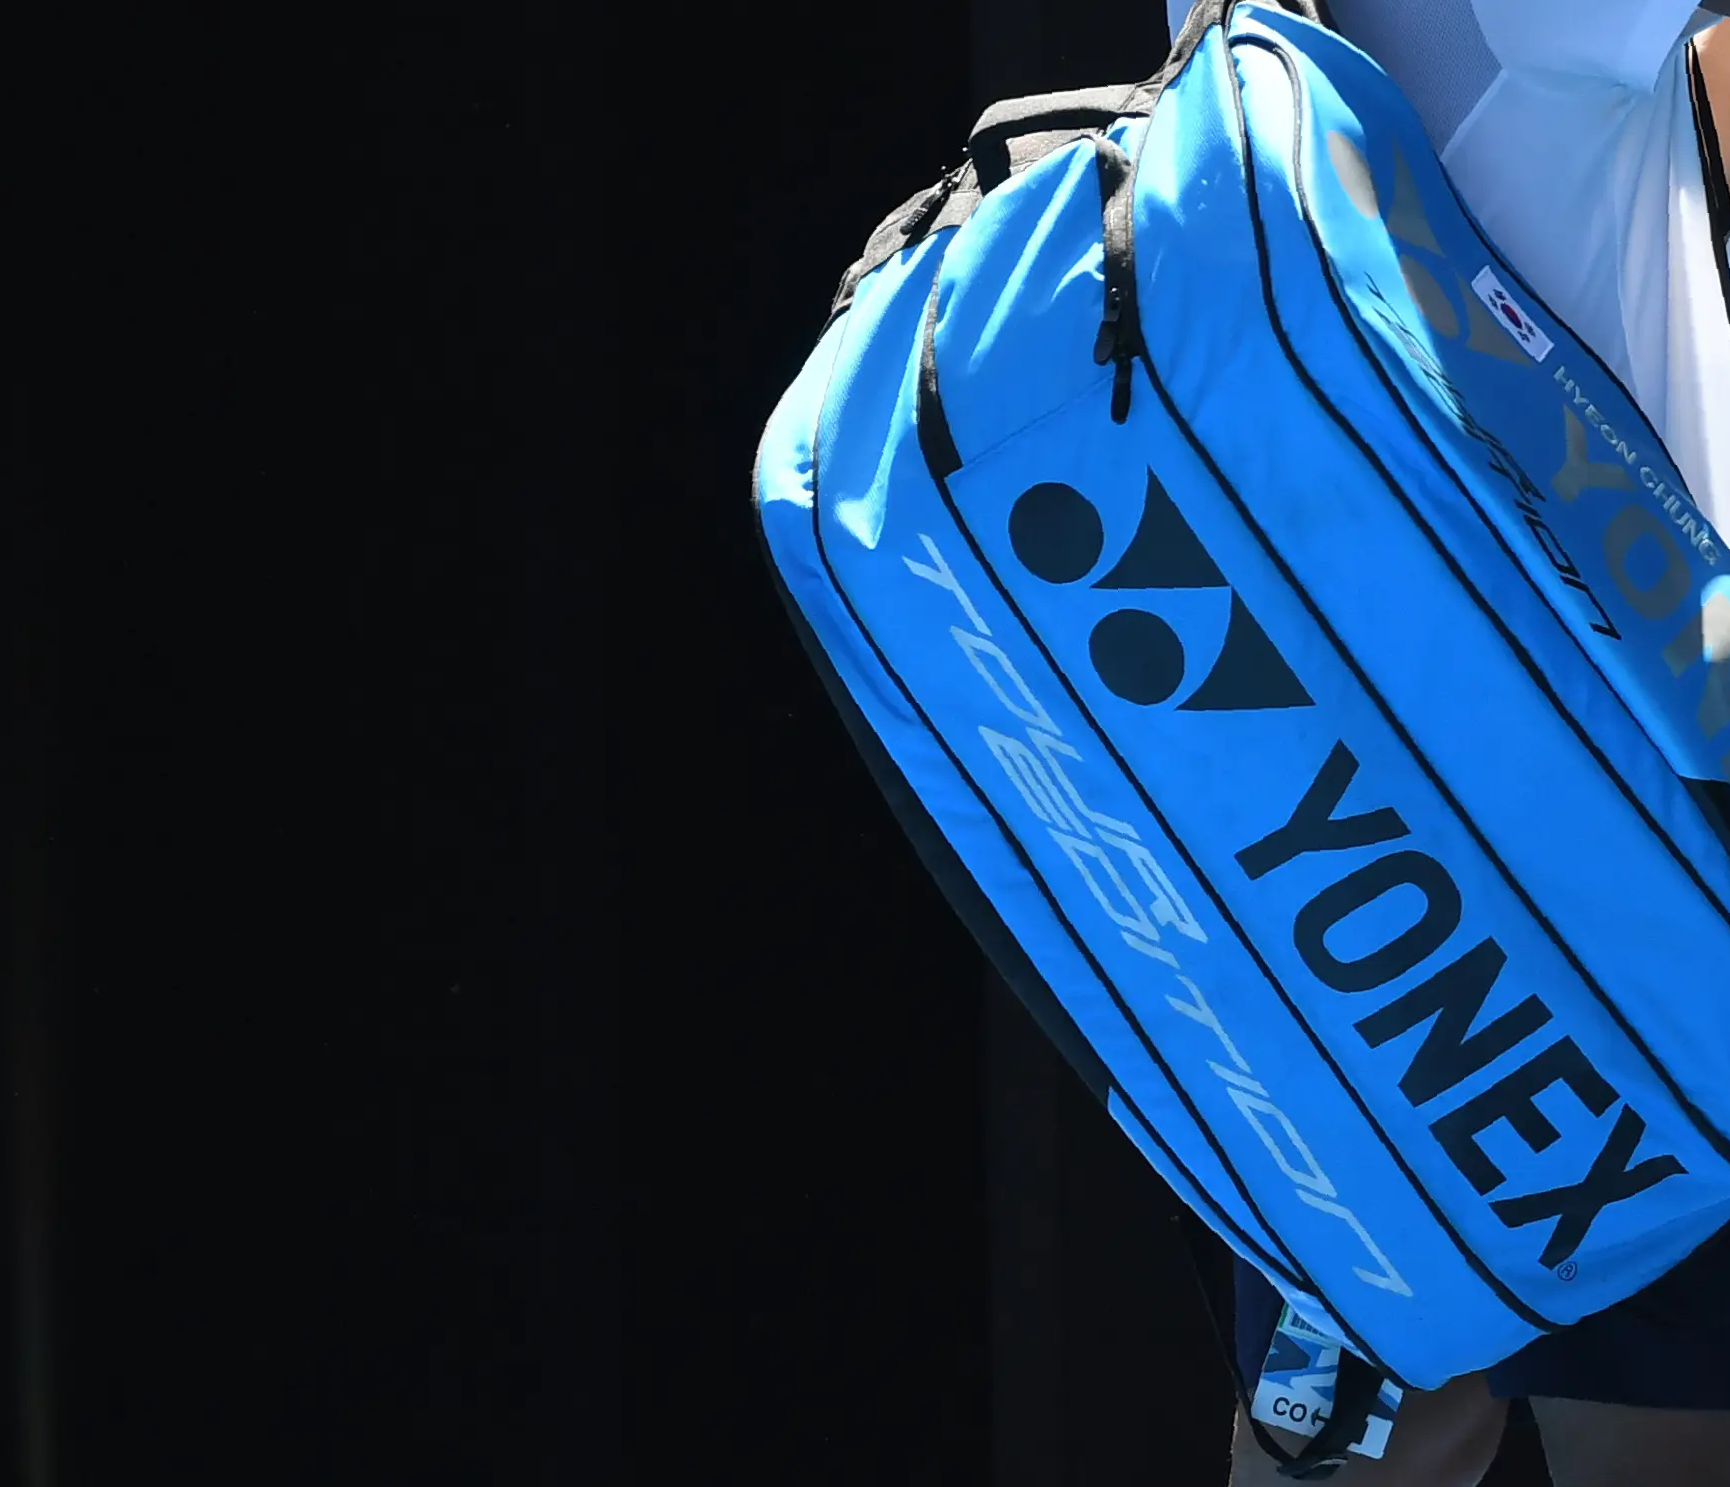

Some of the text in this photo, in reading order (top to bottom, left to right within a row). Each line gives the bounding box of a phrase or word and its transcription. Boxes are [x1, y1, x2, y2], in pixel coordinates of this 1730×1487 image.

[1553, 365, 1720, 567] HYEON CHUNG
[901, 533, 1208, 944] TOUR
[978, 724, 1413, 1297] EDITION
[1233, 737, 1690, 1271] YONEX
